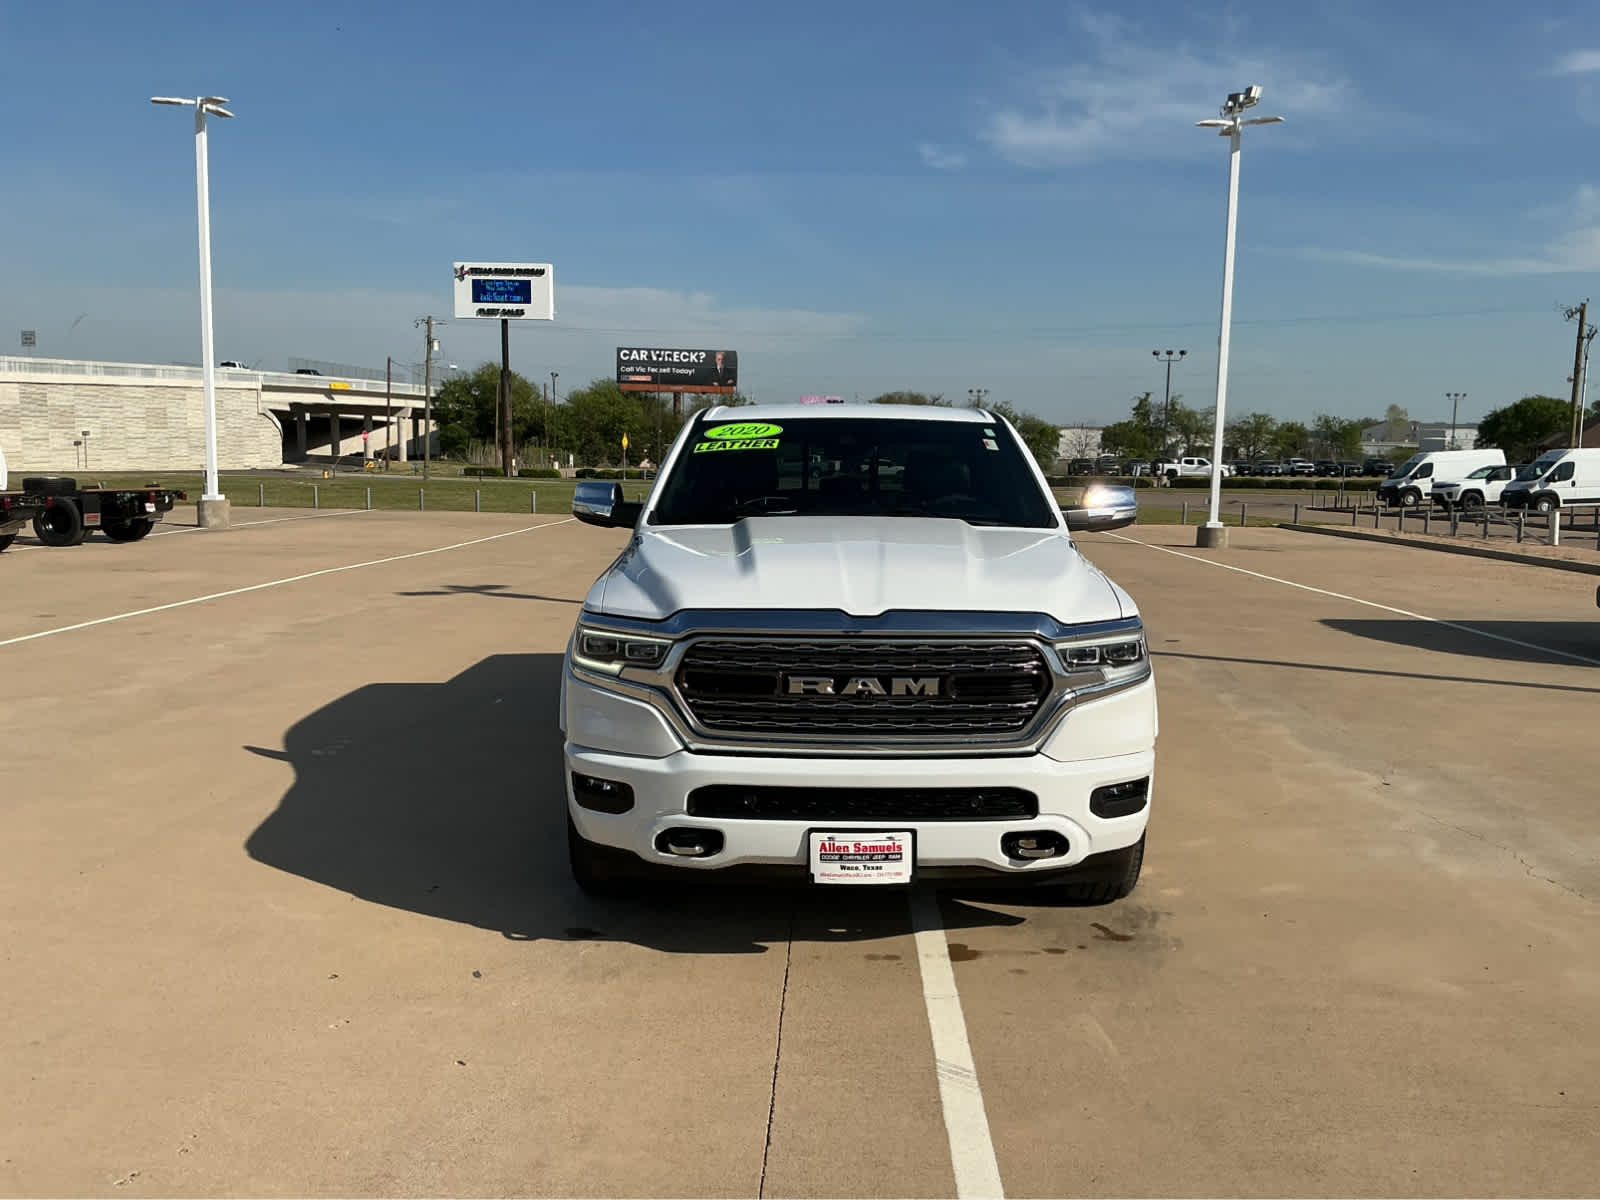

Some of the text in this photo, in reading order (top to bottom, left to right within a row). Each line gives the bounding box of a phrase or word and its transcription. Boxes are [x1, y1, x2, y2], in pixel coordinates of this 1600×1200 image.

[500, 308, 525, 317] SALES
[620, 349, 648, 361] CAR
[672, 367, 695, 377] Today!
[716, 425, 770, 437] 2020
[696, 439, 776, 452] LEATHER
[787, 676, 940, 696] RAM
[820, 842, 903, 853] Allen Samuels
